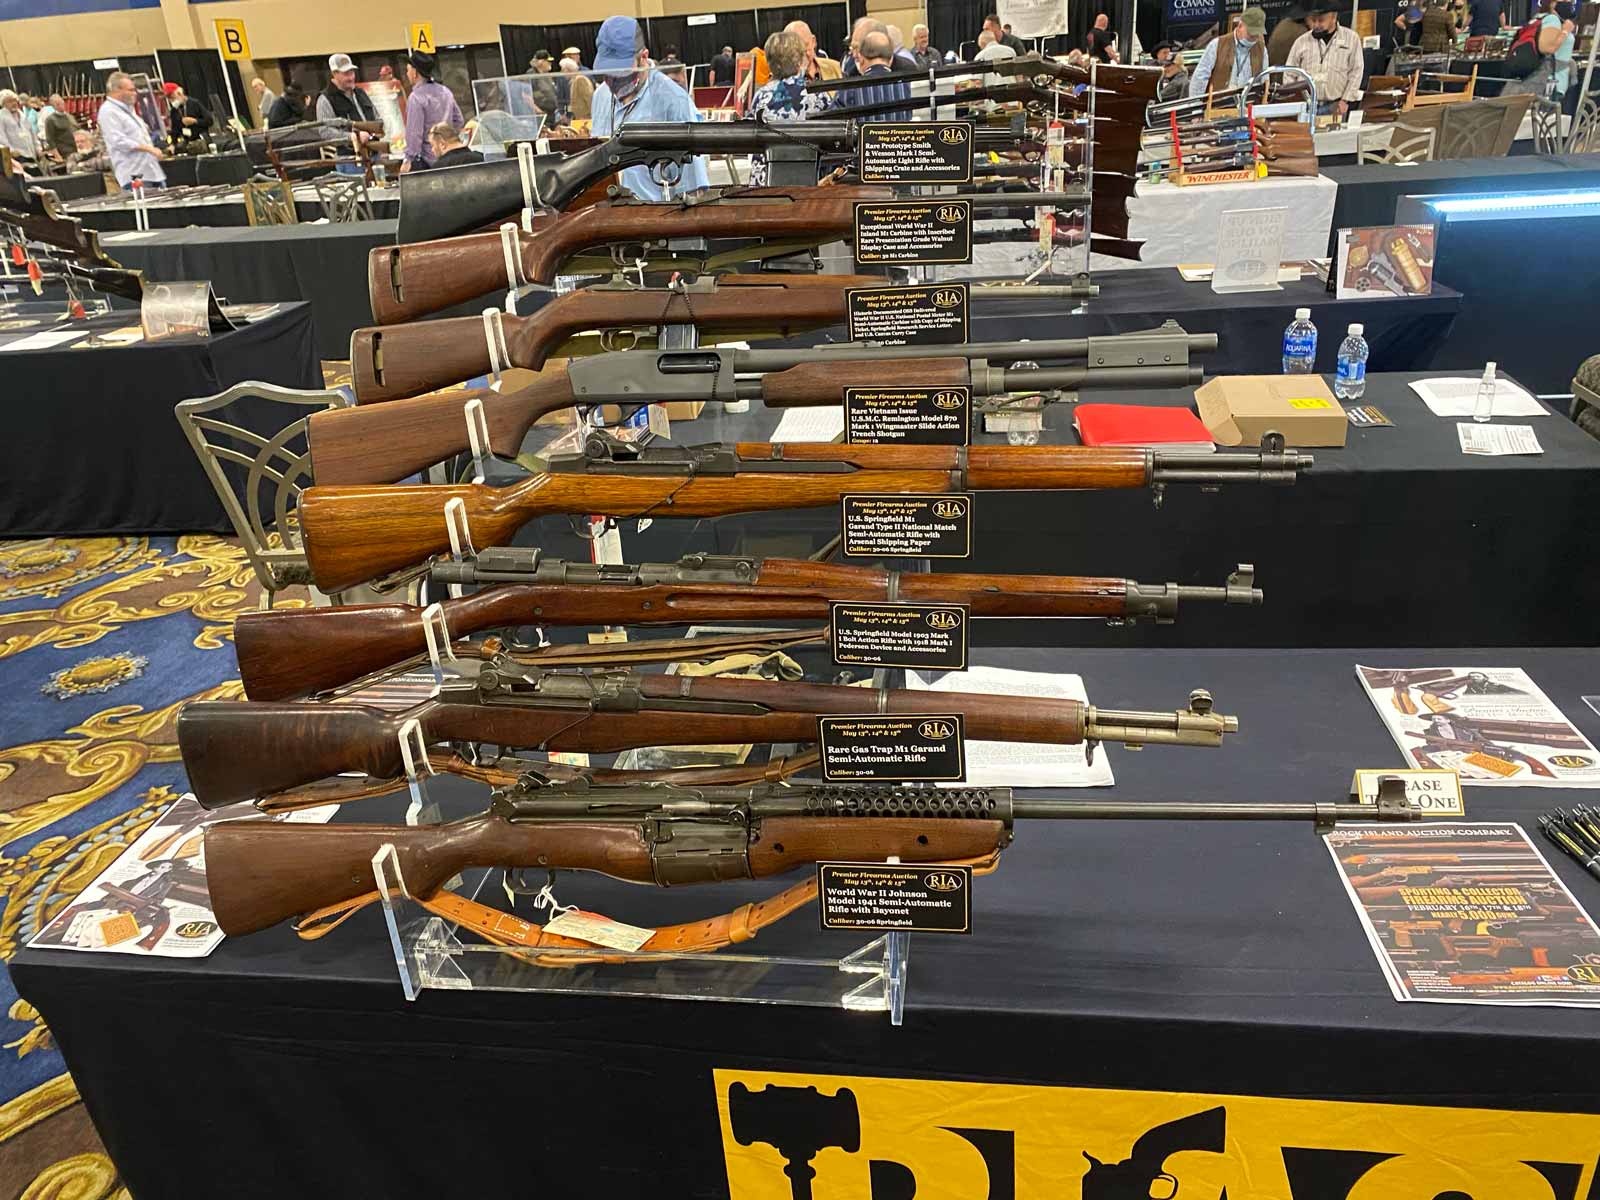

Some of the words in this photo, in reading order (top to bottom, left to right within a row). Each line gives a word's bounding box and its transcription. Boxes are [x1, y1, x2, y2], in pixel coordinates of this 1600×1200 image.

[224, 29, 243, 54] B
[417, 30, 430, 48] A
[943, 129, 963, 140] RIA
[1187, 171, 1249, 183] WINCHESTER
[940, 207, 961, 219] RIA
[936, 292, 959, 304] RIA
[938, 393, 960, 406] RIA
[938, 503, 962, 516] RIA
[931, 613, 955, 625] RIA
[924, 723, 950, 736] RIA
[870, 746, 893, 754] Trap
[1553, 756, 1591, 768] RIA
[1418, 794, 1457, 808] ONE
[930, 875, 958, 888] RIA
[827, 888, 855, 896] World
[889, 890, 927, 898] Johnson
[879, 899, 951, 907] Semi-Automatic
[1403, 896, 1468, 904] FIREARMS
[1470, 896, 1527, 904] AUCTION
[873, 907, 909, 916] Bayonet
[178, 923, 211, 936] RIA
